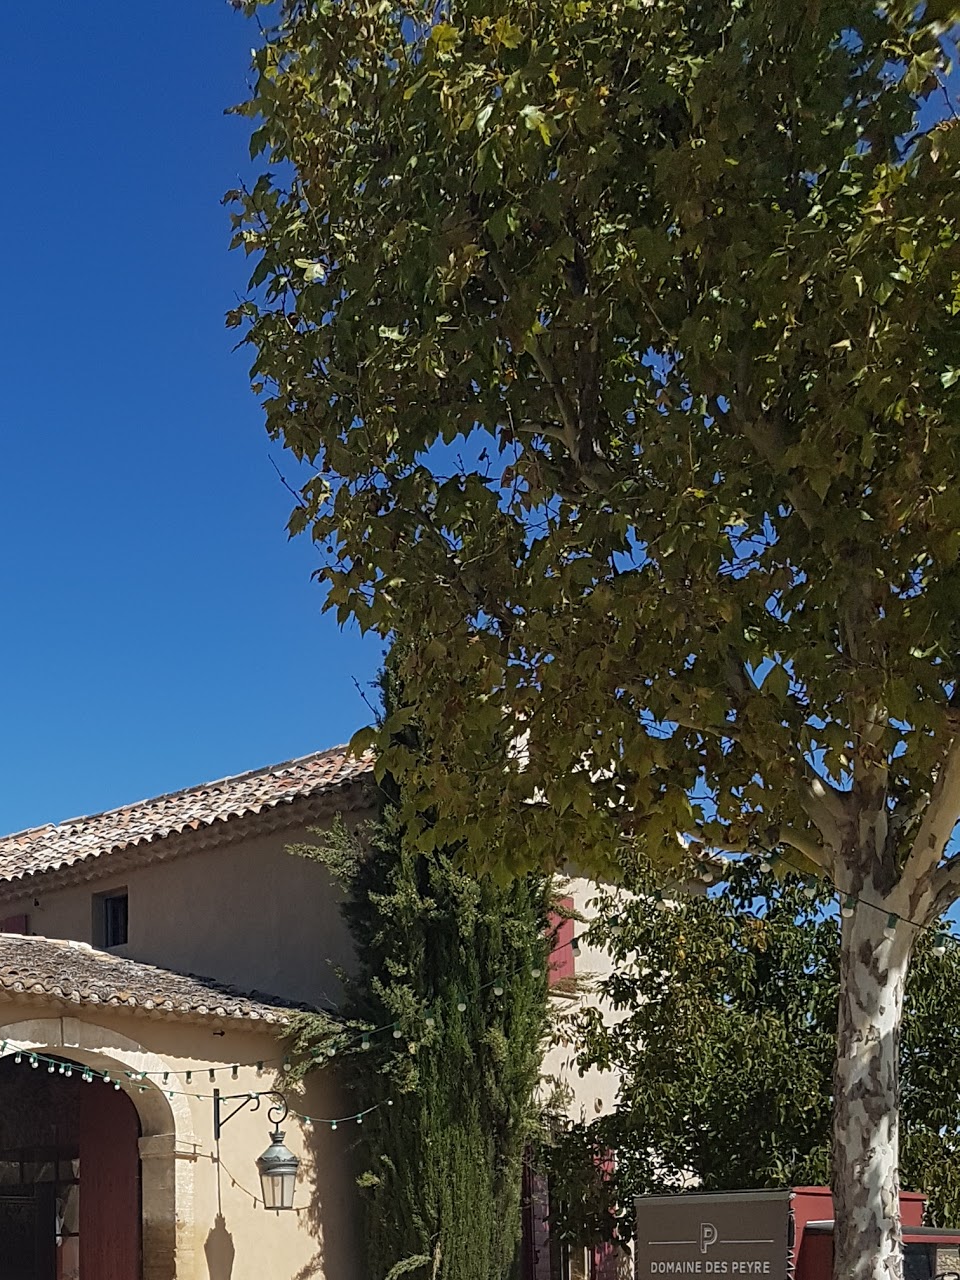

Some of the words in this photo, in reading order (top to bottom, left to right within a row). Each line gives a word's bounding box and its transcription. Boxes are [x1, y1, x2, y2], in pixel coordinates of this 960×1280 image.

[650, 1261, 702, 1274] DOMAINE
[705, 1261, 728, 1274] DES
[731, 1261, 770, 1274] PEYRE
